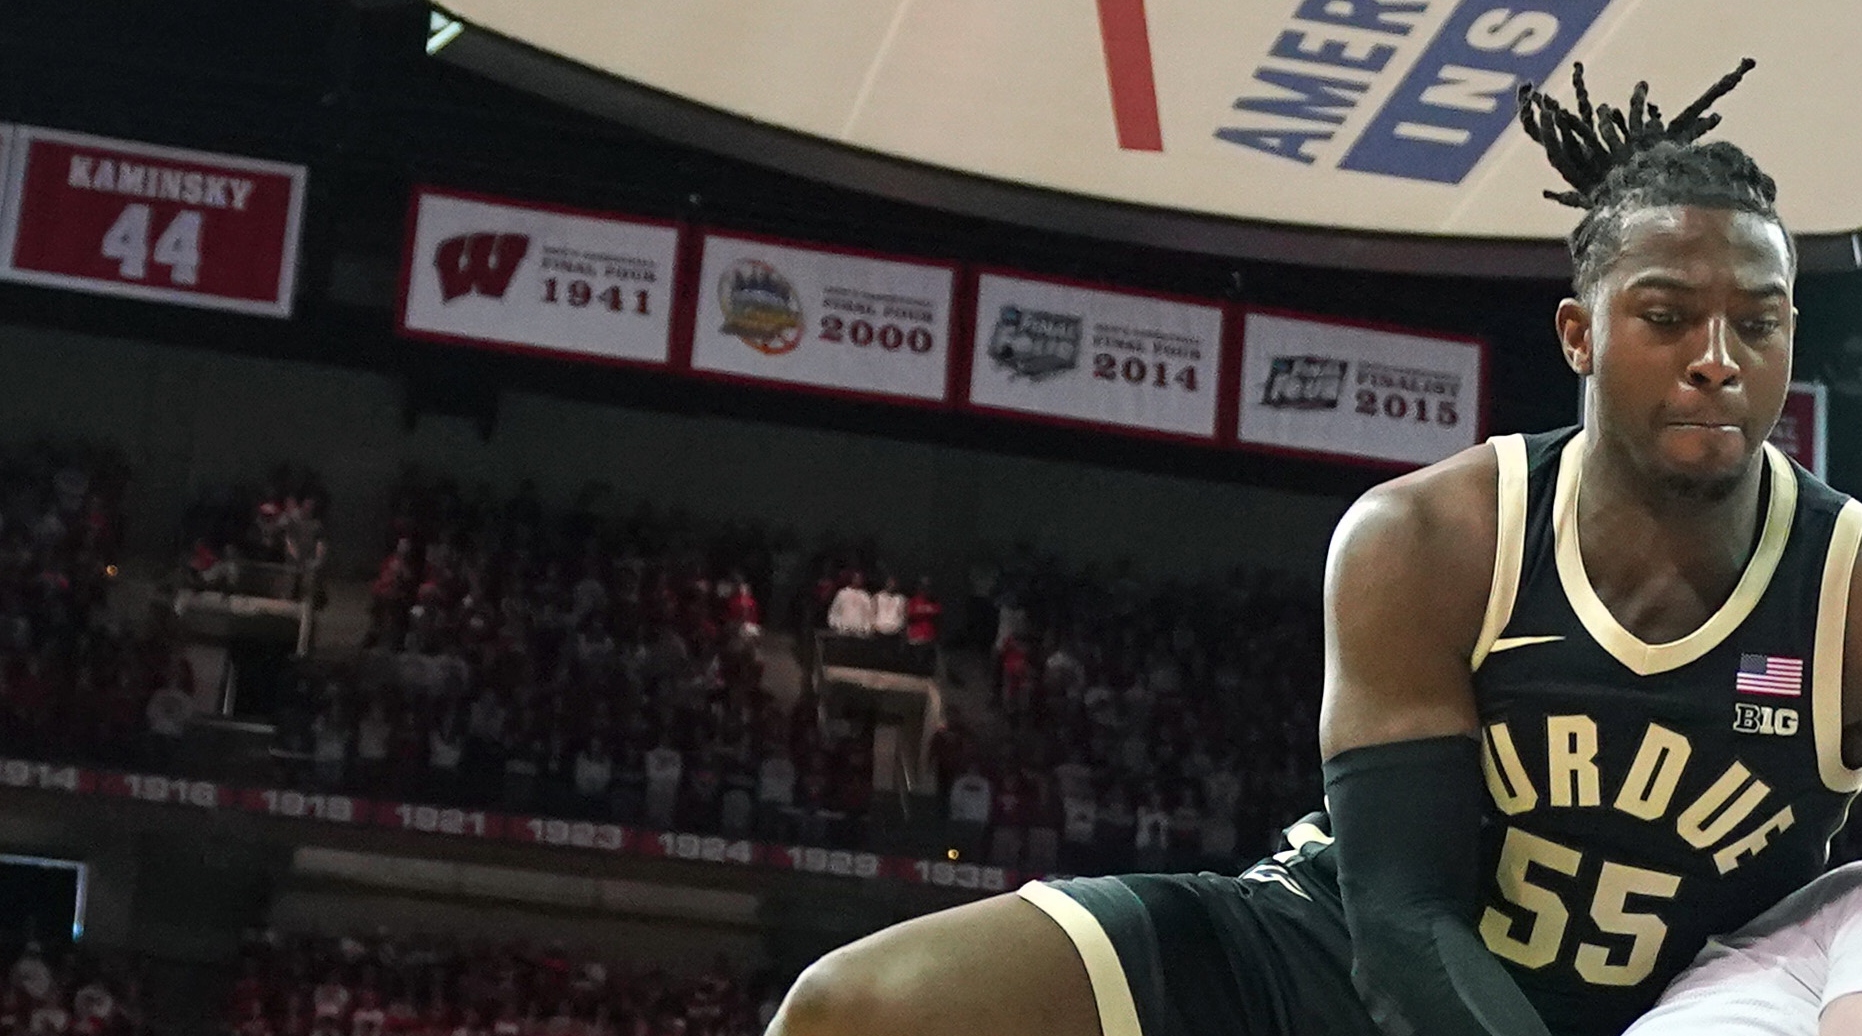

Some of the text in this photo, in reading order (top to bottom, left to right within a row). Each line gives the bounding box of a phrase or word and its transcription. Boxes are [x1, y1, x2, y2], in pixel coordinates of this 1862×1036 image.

[67, 154, 255, 211] KAMINSKY
[101, 202, 205, 286] 44
[542, 277, 650, 315] 1941
[818, 314, 933, 353] 2000
[1093, 352, 1196, 391] 2014
[1355, 388, 1458, 426] 2015
[1481, 714, 1795, 876] URDUE
[1478, 826, 1683, 987] 55
